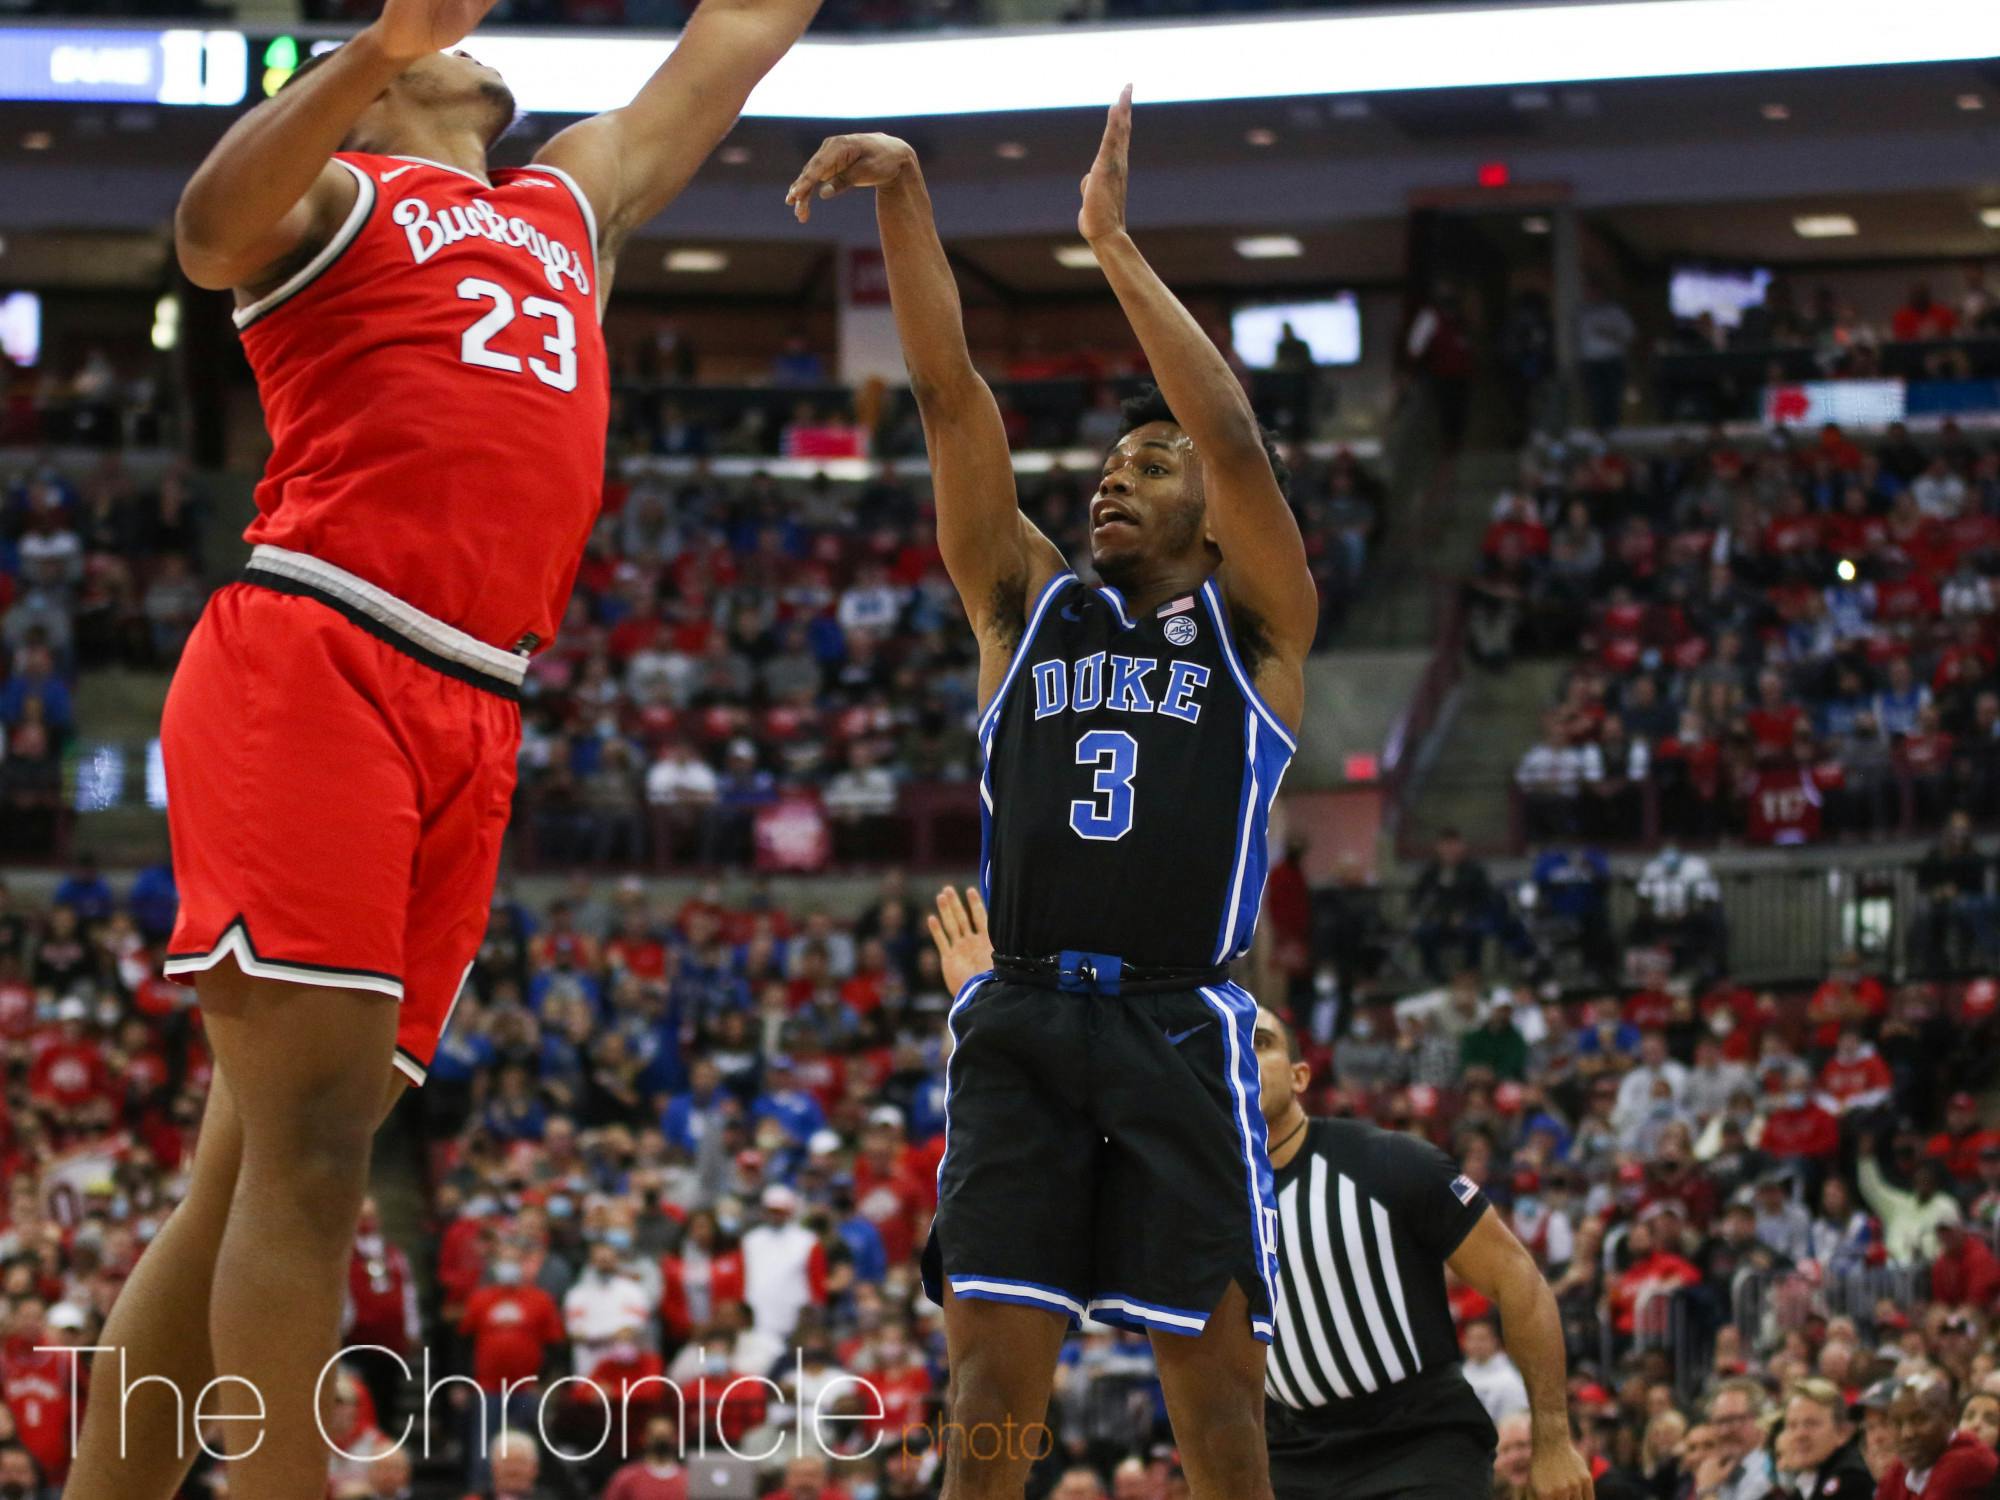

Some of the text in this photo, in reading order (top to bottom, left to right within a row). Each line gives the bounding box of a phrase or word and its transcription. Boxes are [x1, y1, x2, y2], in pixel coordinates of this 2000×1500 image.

[392, 198, 590, 295] Buckeyes
[456, 277, 578, 393] 23
[1032, 651, 1211, 724] DUKE
[1069, 730, 1138, 841] 3
